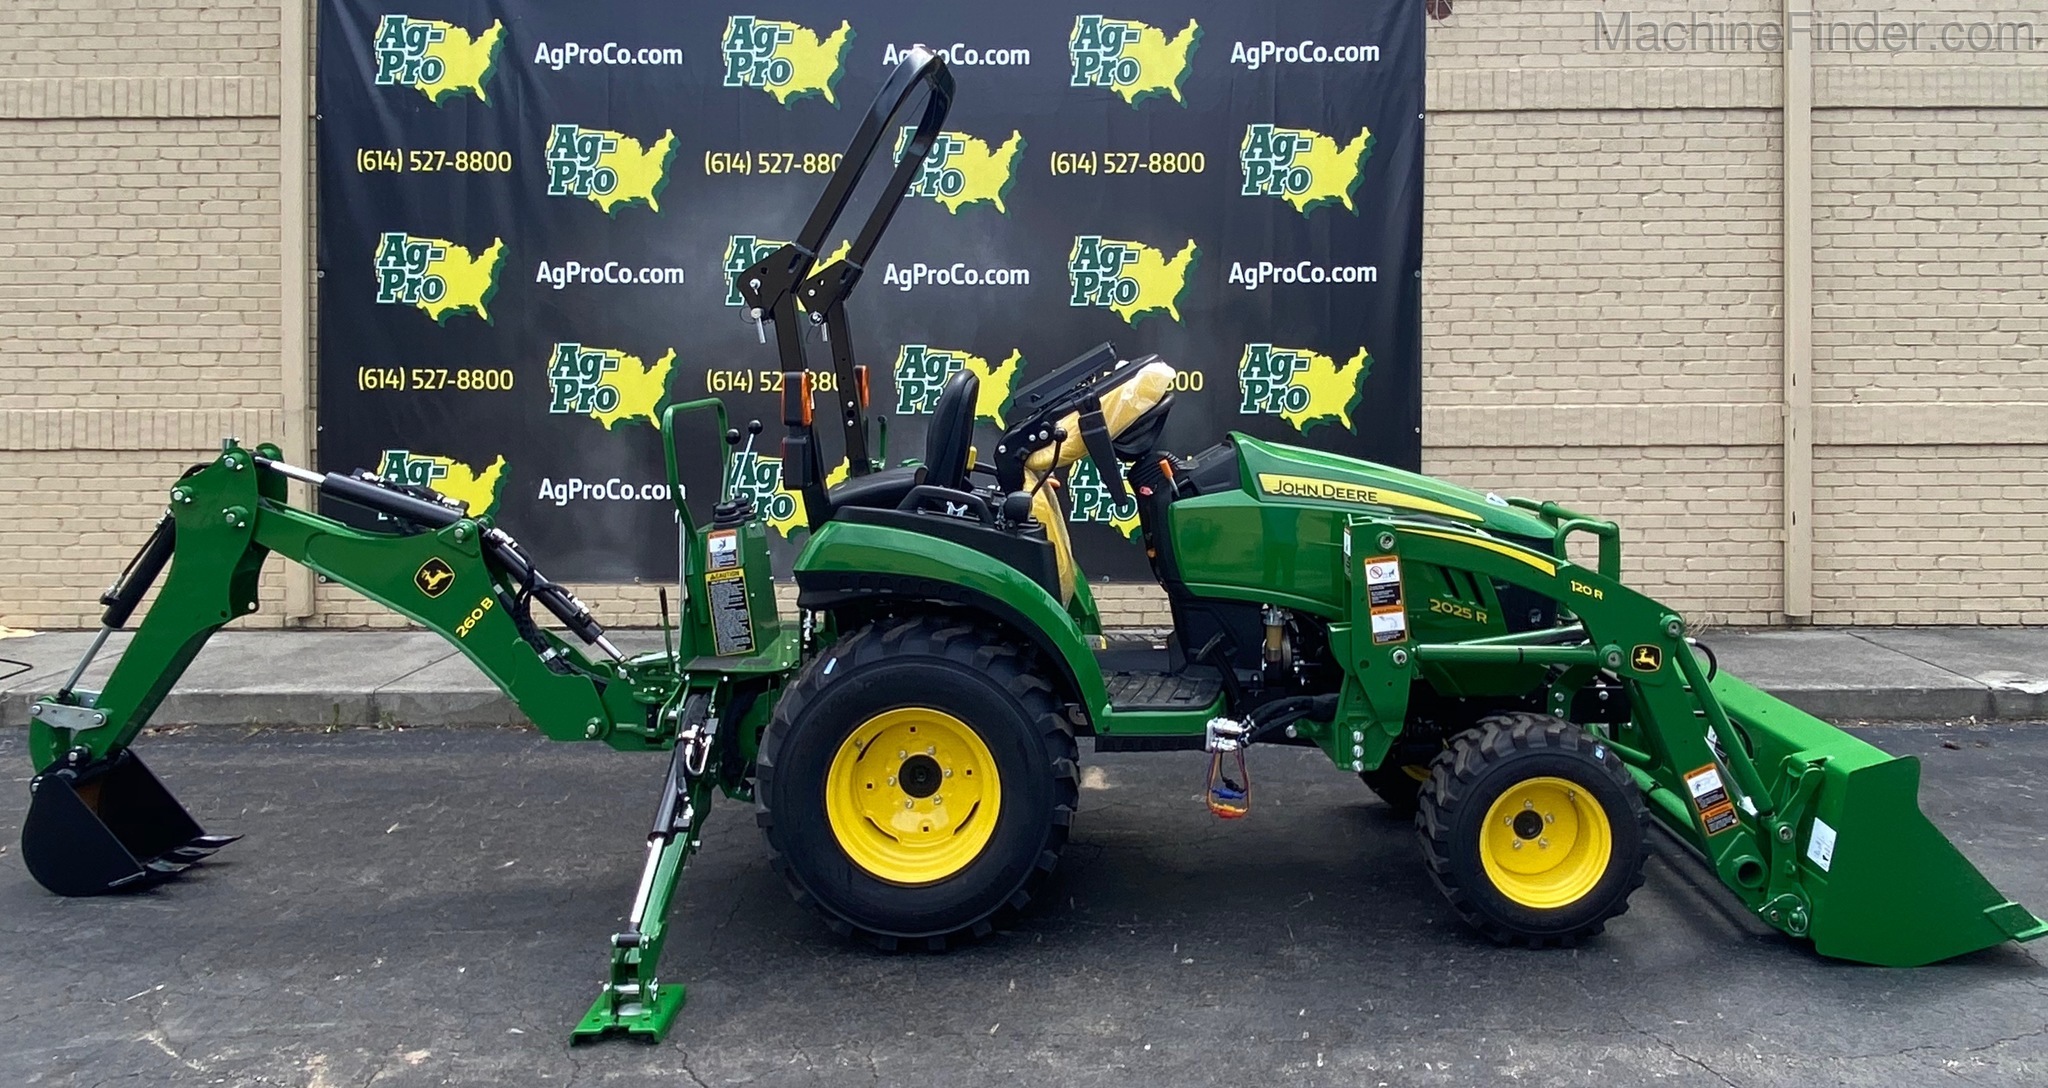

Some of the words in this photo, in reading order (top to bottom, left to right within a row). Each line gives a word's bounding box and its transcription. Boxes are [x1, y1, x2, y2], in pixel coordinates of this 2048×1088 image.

[377, 15, 446, 57] Ag-
[725, 16, 793, 58] Ag-
[1072, 15, 1141, 58] Ag-
[375, 49, 445, 85] Pro
[535, 43, 683, 70] AgProCo.com
[723, 50, 793, 87] Pro
[1071, 49, 1141, 86] Pro
[1231, 41, 1380, 70] AgProCo.com
[358, 149, 402, 173] (614)
[411, 151, 512, 171] 527-8800
[549, 125, 618, 166] Ag-
[705, 151, 751, 175] (614)
[759, 153, 844, 174] 527-880
[1051, 151, 1097, 175] (614)
[1104, 153, 1204, 174] 527-8800
[1243, 124, 1312, 166] Ag-
[548, 159, 618, 196] Pro
[1241, 159, 1312, 196] Pro
[377, 233, 446, 275] Ag-
[1072, 236, 1140, 278] Ag-
[376, 267, 446, 304] Pro
[536, 261, 684, 289] AgProCo.com
[883, 263, 1030, 291] AgProCo.com
[1070, 270, 1139, 307] Pro
[1229, 261, 1377, 289] AgProCo.com
[359, 367, 405, 391] (614)
[413, 369, 514, 389] 527-8800
[552, 343, 619, 385] Ag-
[707, 369, 753, 393] (614)
[896, 345, 964, 387] Ag-
[1243, 344, 1310, 385] Ag-
[550, 377, 619, 414] Pro
[896, 378, 943, 414] Pr
[1241, 378, 1310, 414] Pro
[1273, 480, 1319, 497] JOHN
[1322, 484, 1379, 503] DEERE
[1570, 580, 1593, 596] 120
[1594, 589, 1604, 601] R
[455, 608, 485, 638] 260
[480, 597, 495, 611] B
[1429, 598, 1473, 620] 2025
[1476, 610, 1488, 625] R
